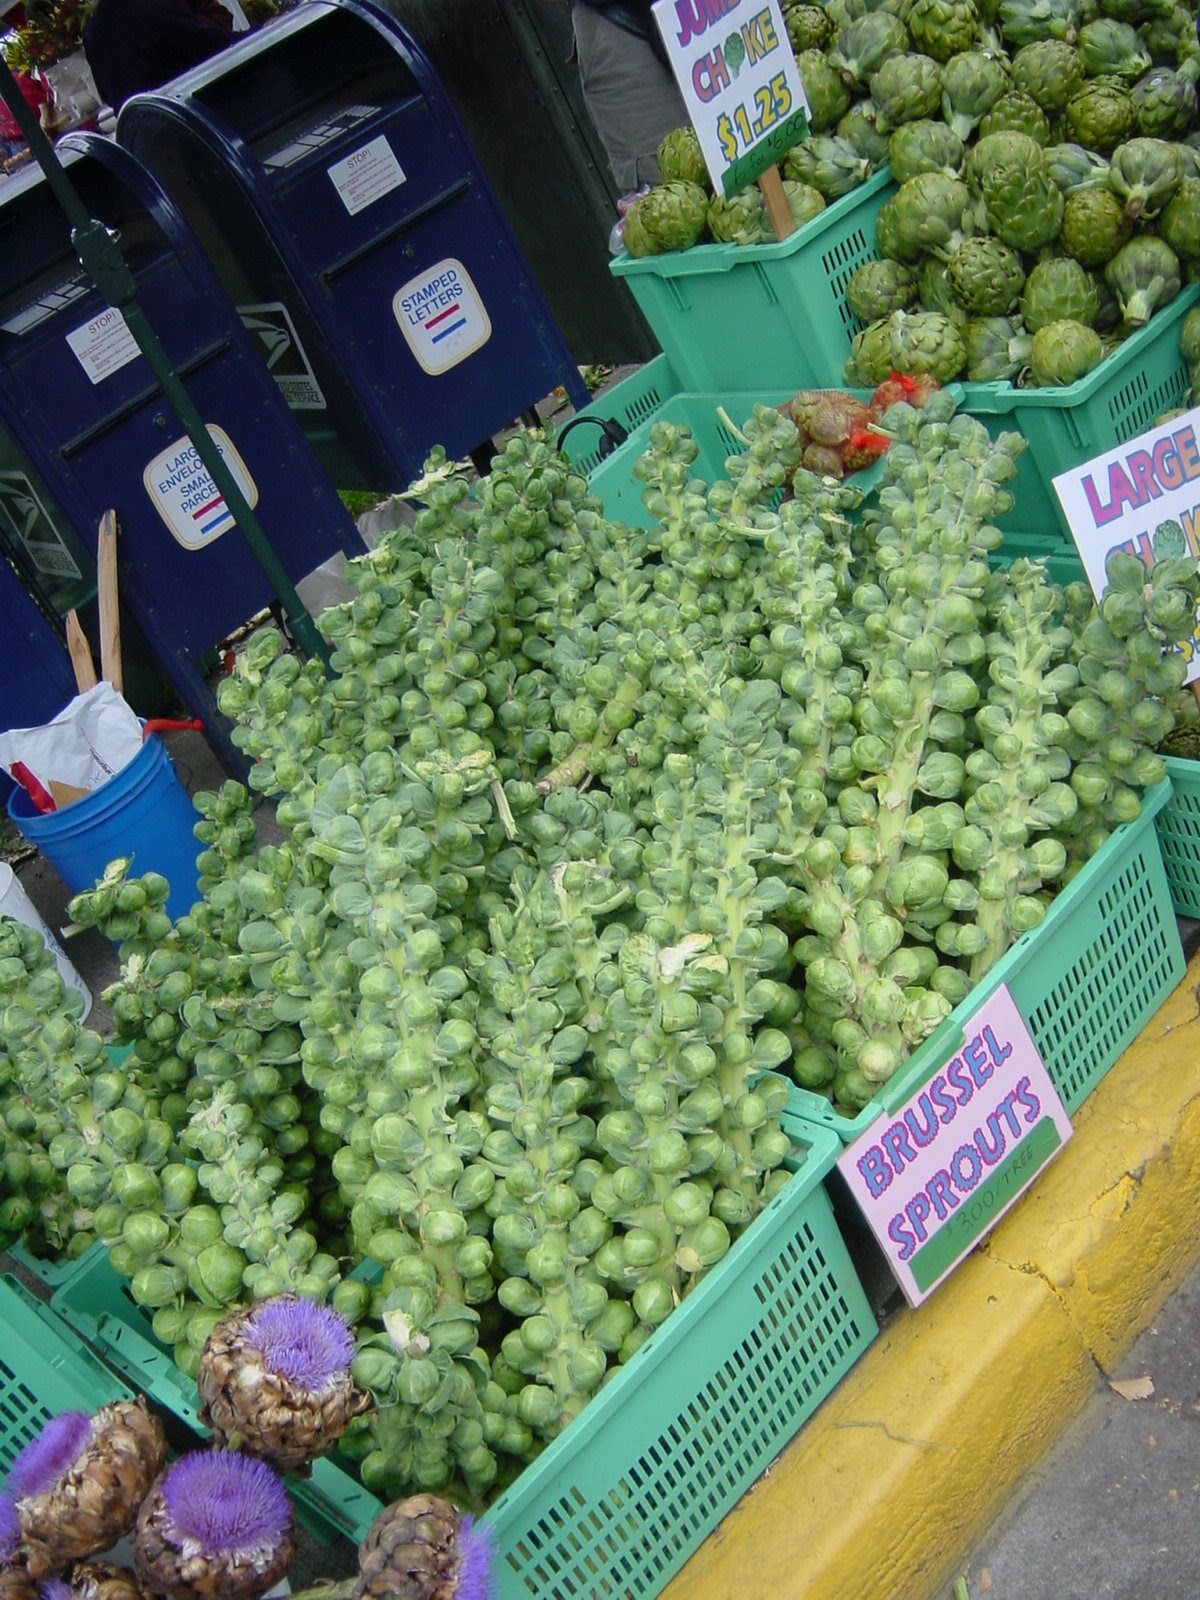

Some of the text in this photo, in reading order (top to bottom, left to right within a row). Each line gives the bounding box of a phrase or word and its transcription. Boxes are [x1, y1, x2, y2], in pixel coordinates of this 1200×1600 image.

[717, 70, 792, 164] $1.25
[346, 149, 372, 169] STOP!
[734, 163, 746, 186] 6
[750, 152, 766, 168] for
[401, 269, 457, 312] STAMPED
[408, 283, 463, 325] LETTERS
[88, 312, 117, 334] STOP!
[166, 447, 197, 473] LARG
[1081, 424, 1200, 528] LARGE
[180, 473, 213, 497] SMAL
[181, 483, 218, 513] PARCE
[857, 1024, 1013, 1200] BRUSSEL
[888, 1076, 1040, 1260] SPROUTS
